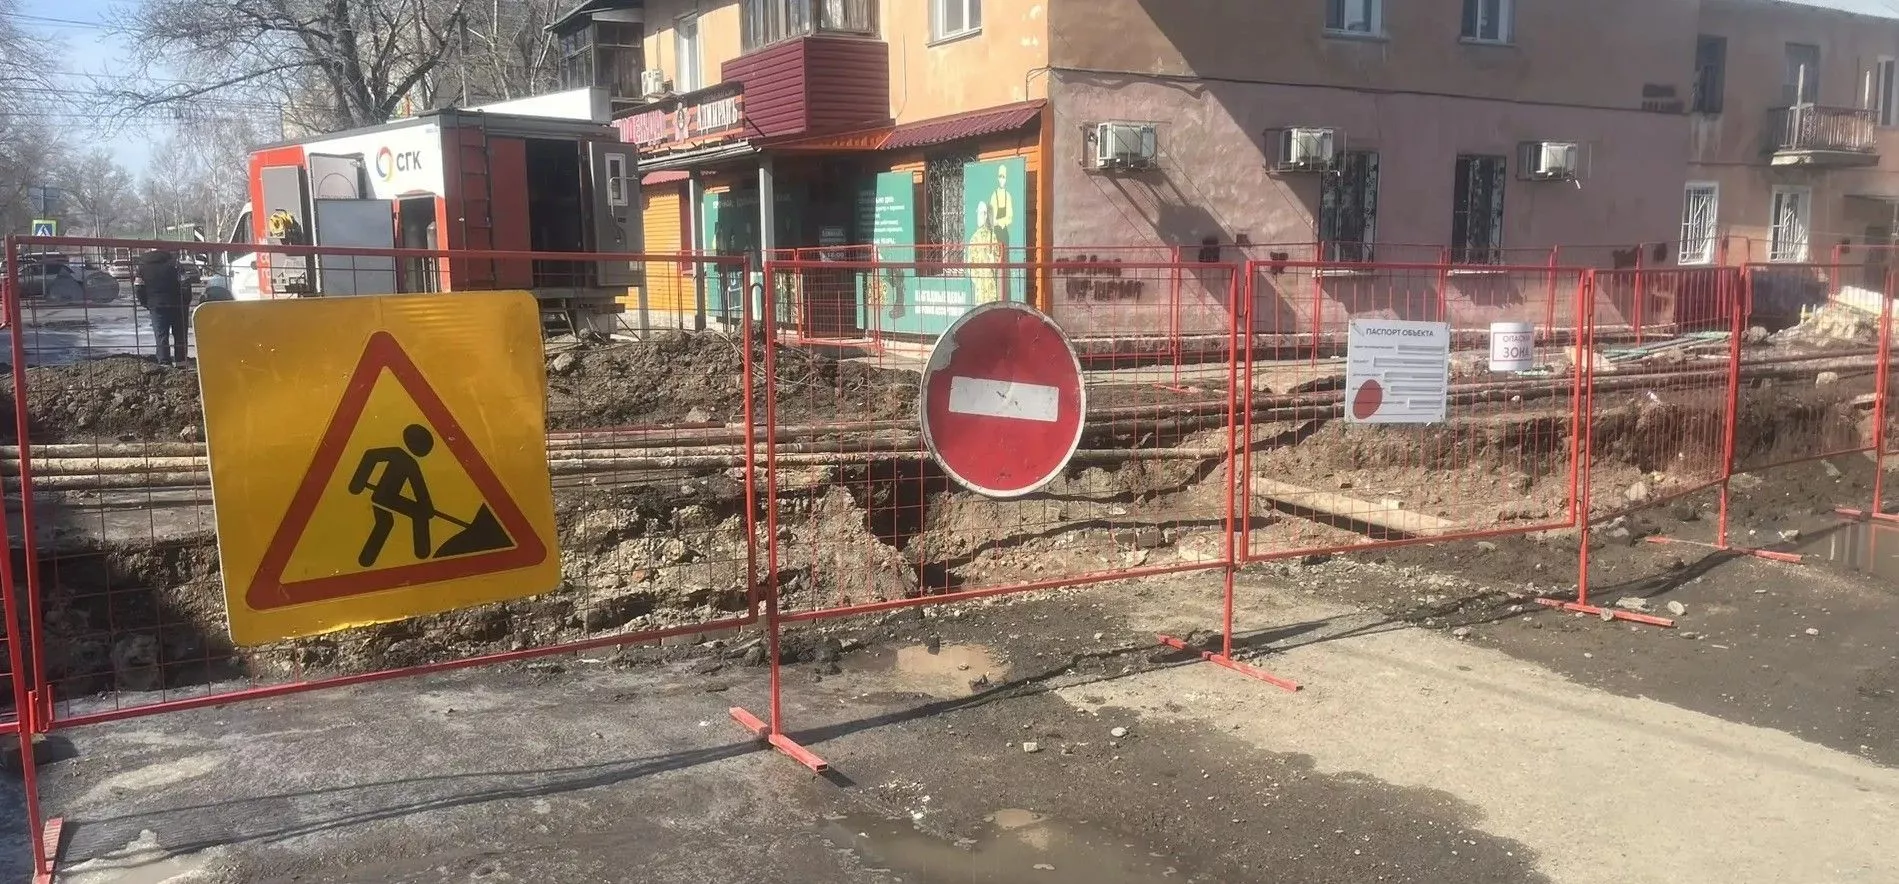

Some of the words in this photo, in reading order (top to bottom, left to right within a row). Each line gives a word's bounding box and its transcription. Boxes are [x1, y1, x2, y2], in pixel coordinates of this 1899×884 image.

[396, 150, 422, 172] СГК
[1366, 327, 1400, 336] ПАСПОРТ
[1401, 329, 1434, 337] ОБЪЕКТА
[1503, 346, 1530, 358] ЗОНА
